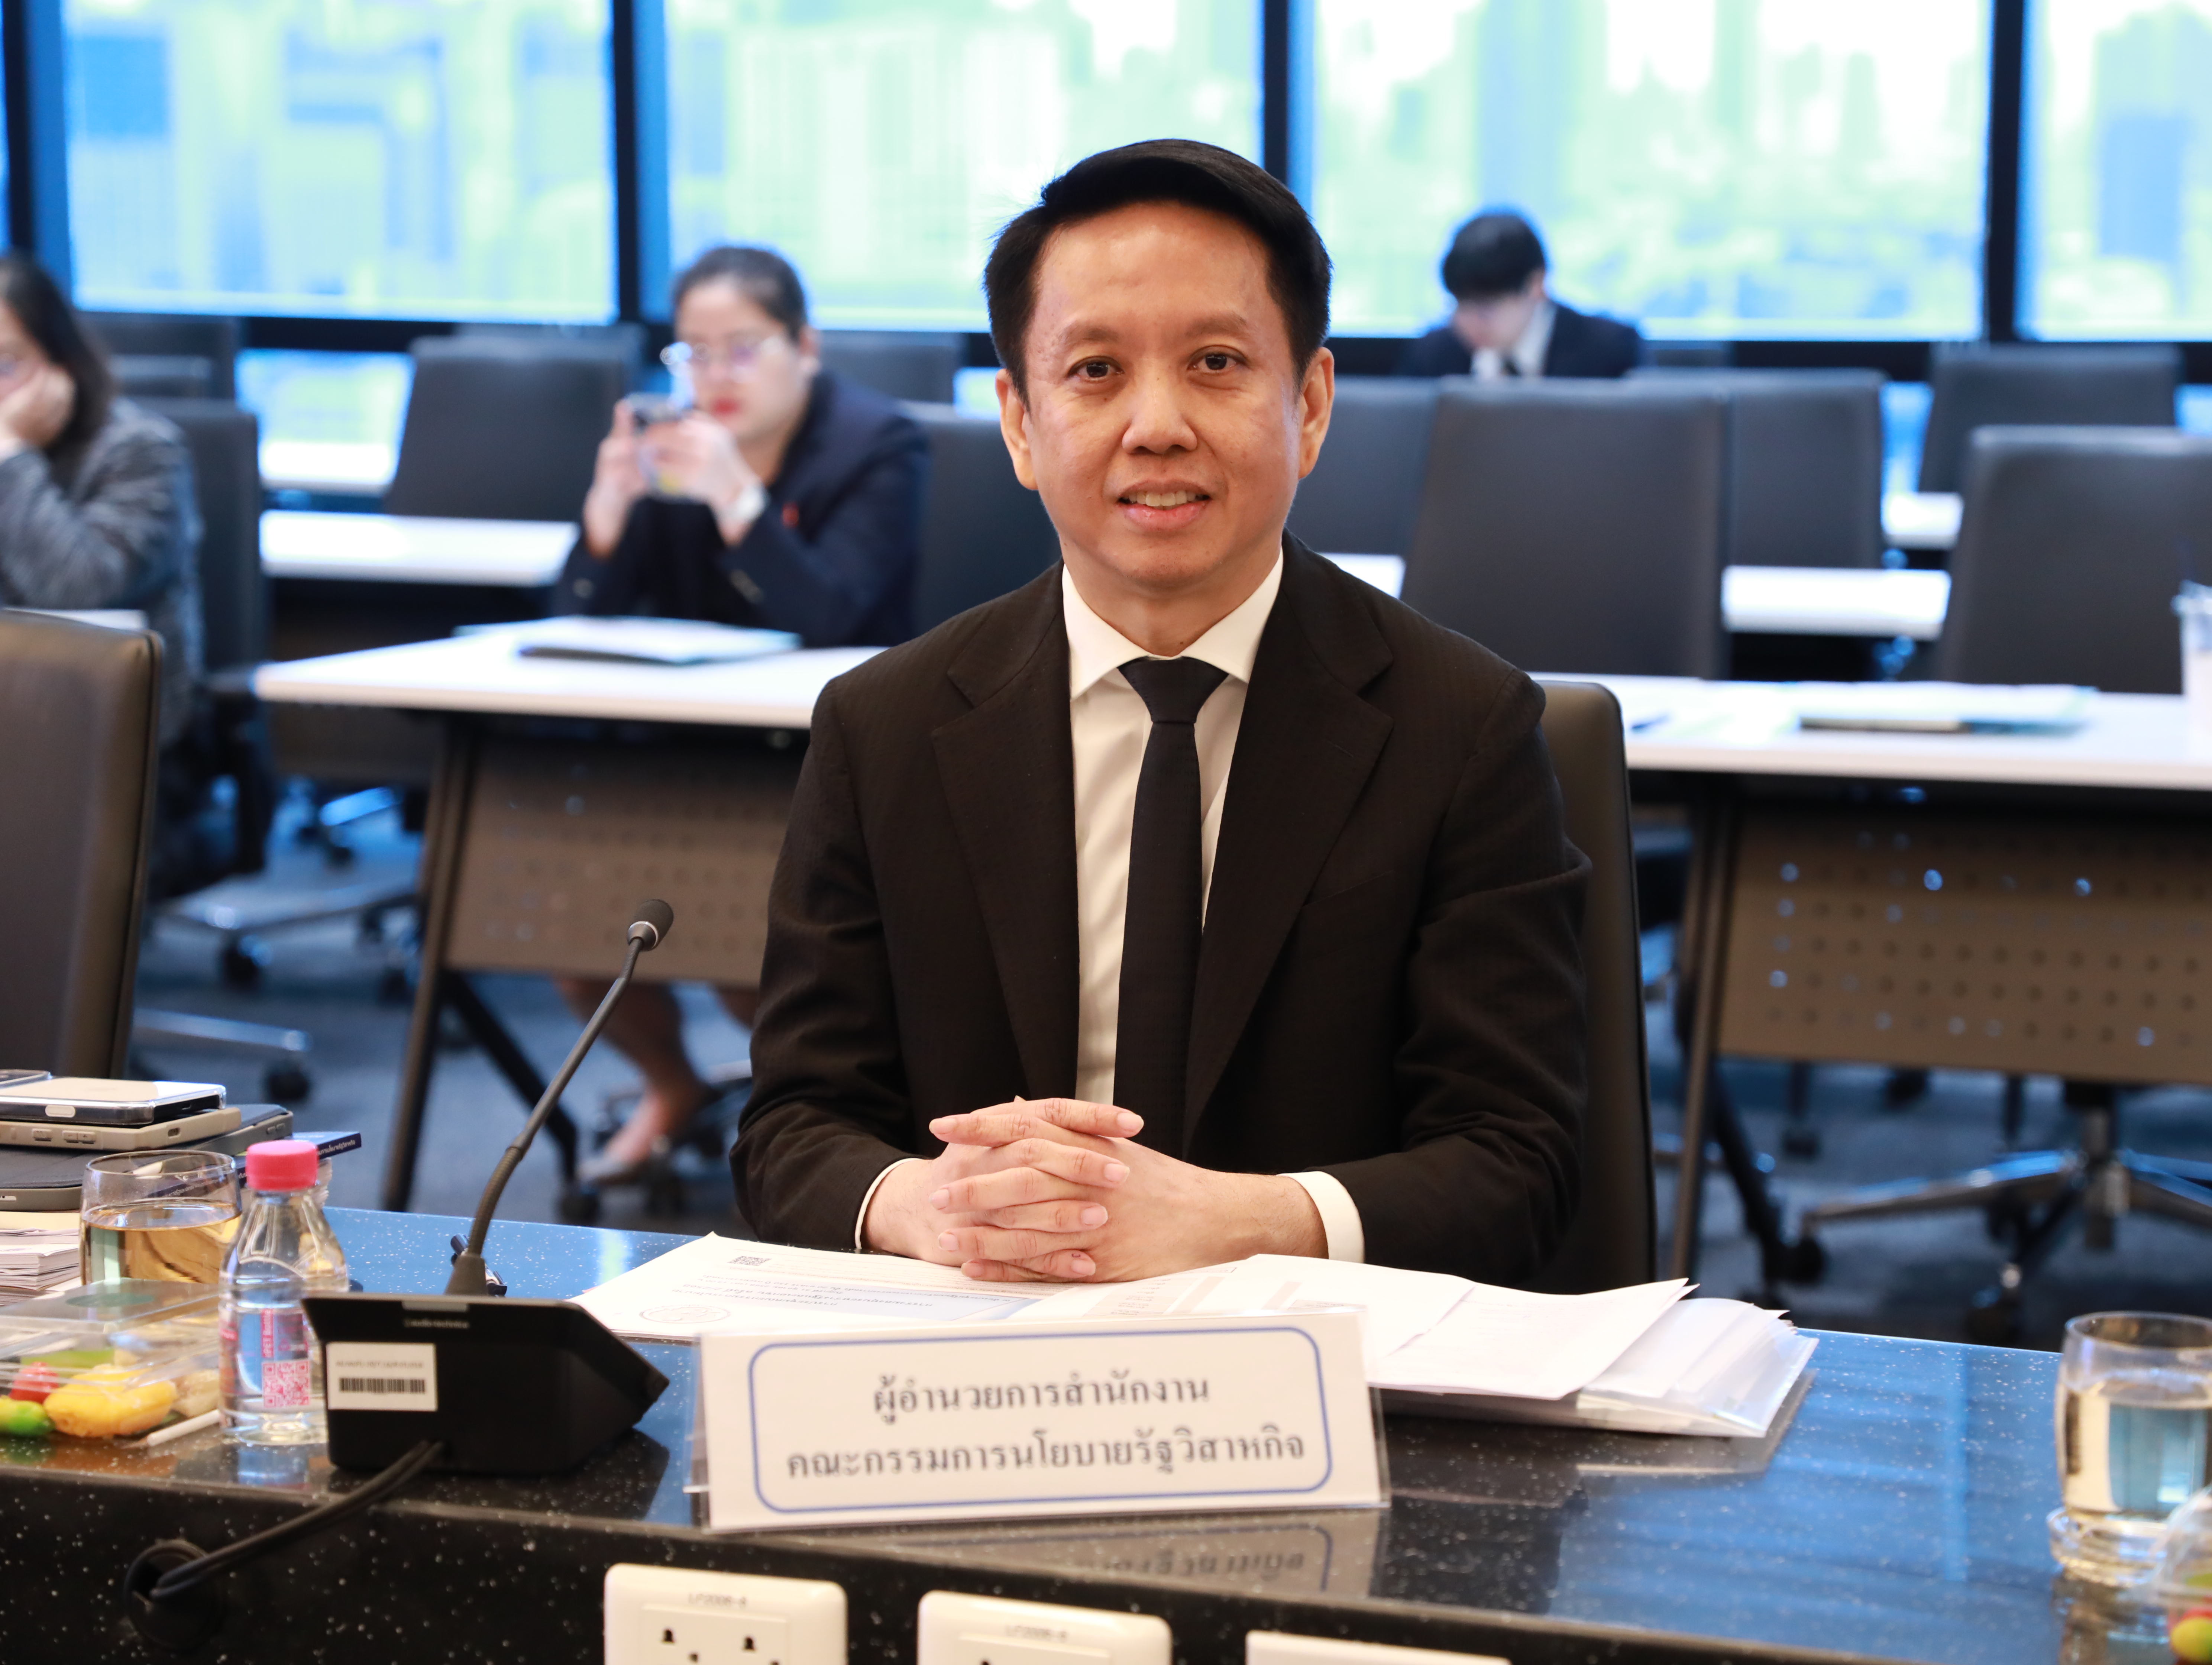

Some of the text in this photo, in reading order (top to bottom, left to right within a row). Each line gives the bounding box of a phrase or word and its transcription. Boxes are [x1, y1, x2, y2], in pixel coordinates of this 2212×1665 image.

[669, 1290, 839, 1306] การประชุมคณะกรรมการนโยบาย
[872, 1368, 1210, 1425] ผู้อำนวยการสำนักงาน
[785, 1422, 1305, 1478] คณะกรรมการนโยบายรัฐวิสาหกิจ
